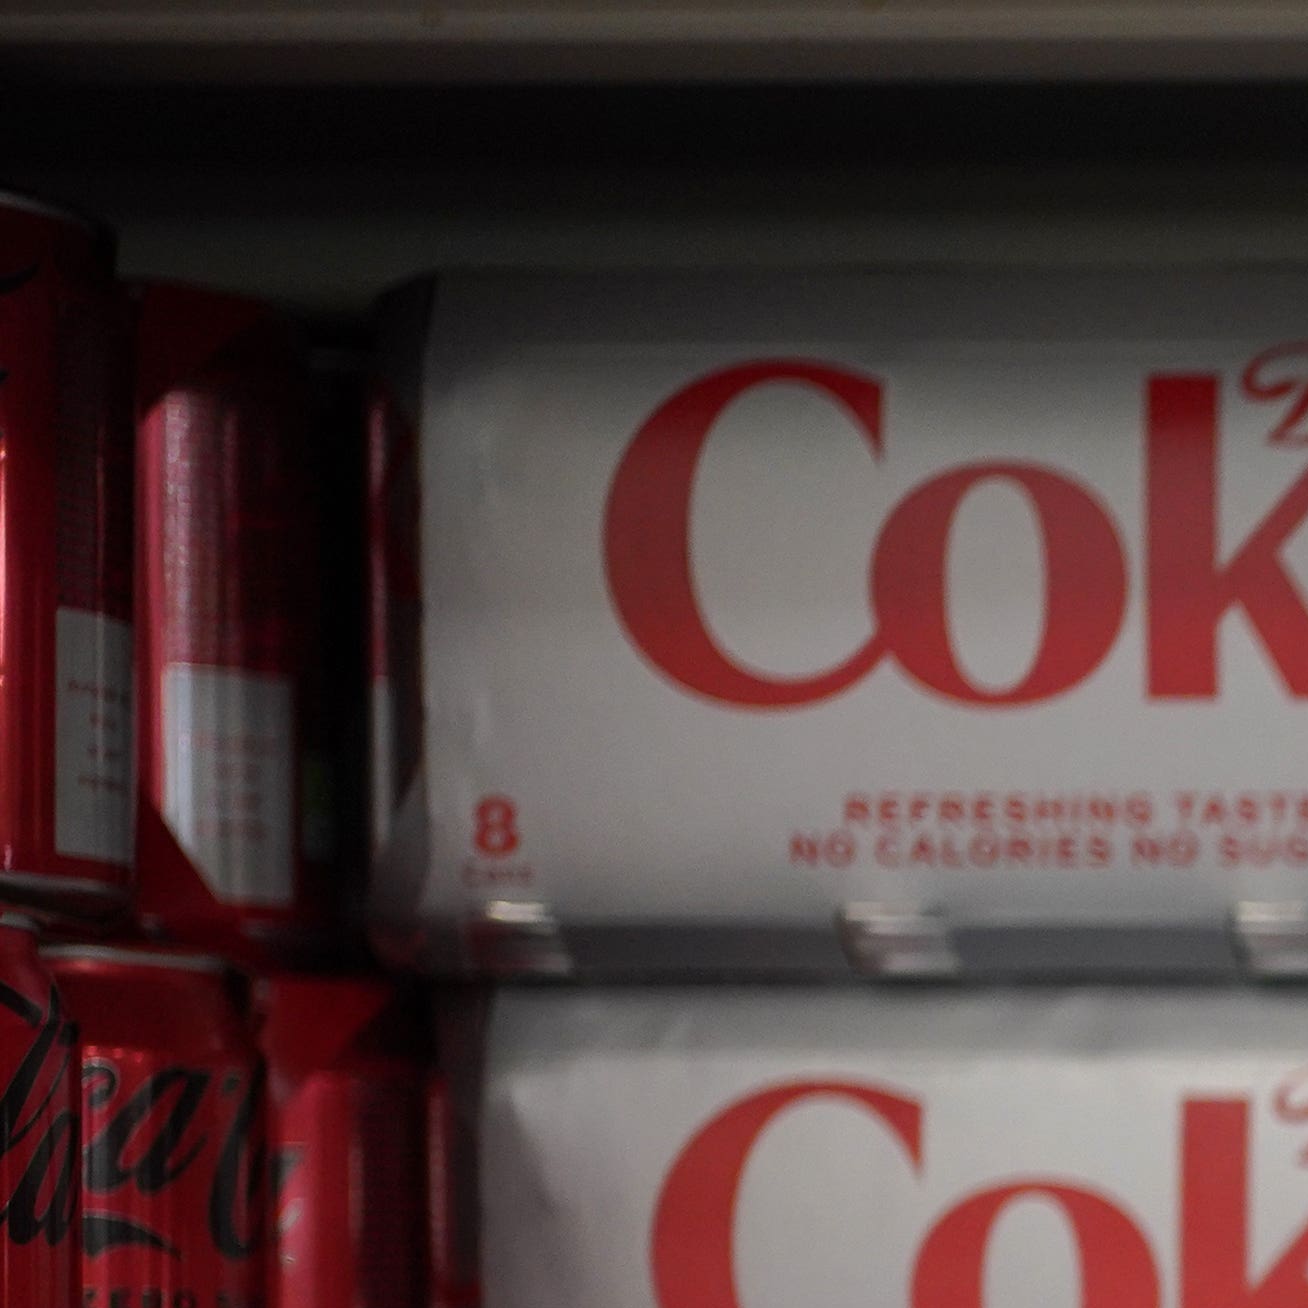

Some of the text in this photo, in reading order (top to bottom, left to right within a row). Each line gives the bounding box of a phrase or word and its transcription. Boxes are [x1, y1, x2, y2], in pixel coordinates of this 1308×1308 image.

[473, 795, 522, 860] 8
[844, 793, 1153, 828] REFRESHING
[789, 833, 857, 867] NO
[874, 833, 1112, 868] CALORIES
[1132, 833, 1198, 866] NO
